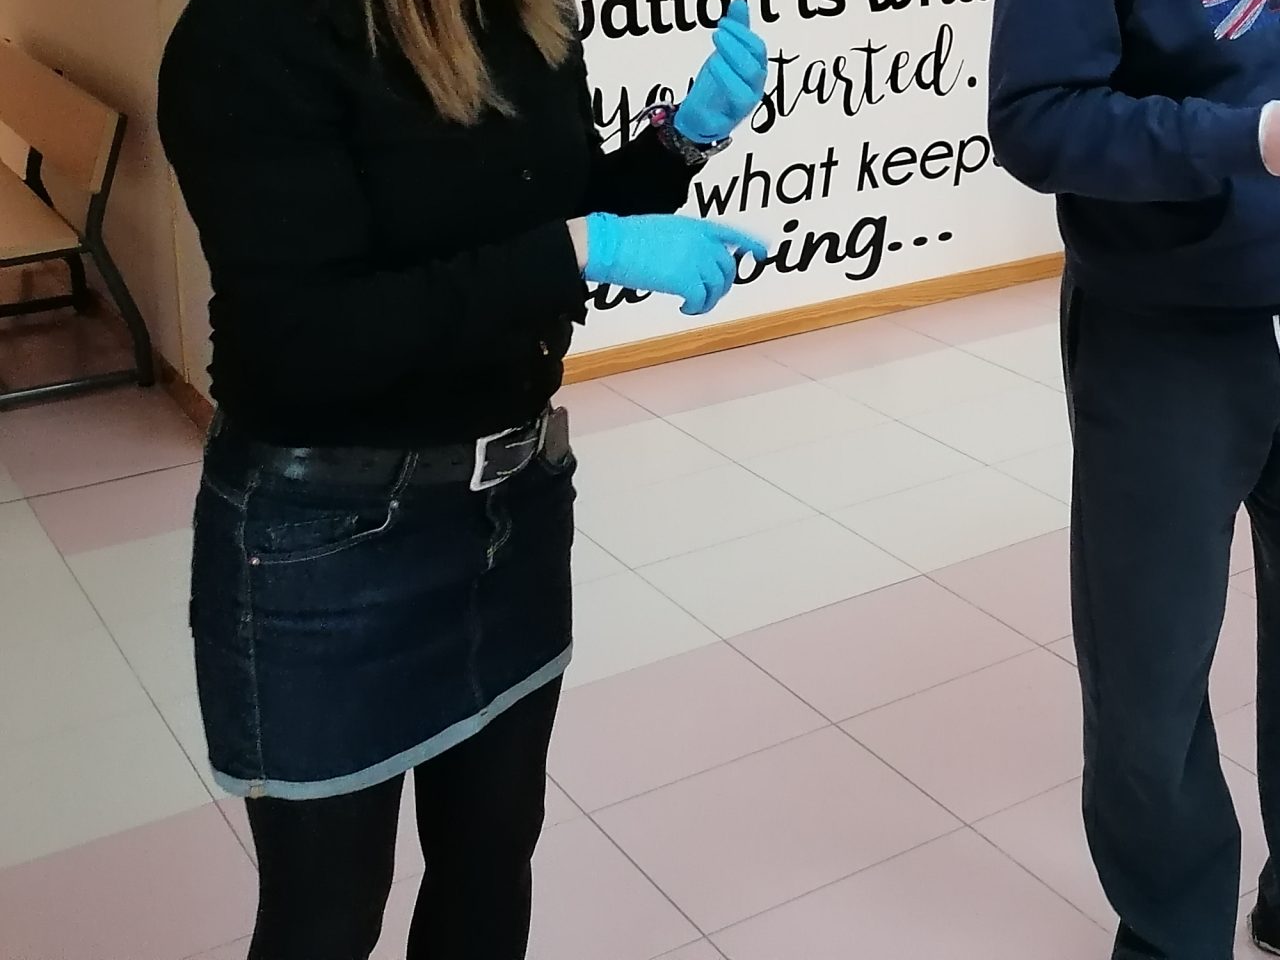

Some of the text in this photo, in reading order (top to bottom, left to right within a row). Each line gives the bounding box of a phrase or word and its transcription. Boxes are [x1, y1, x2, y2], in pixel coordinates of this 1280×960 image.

[694, 134, 1002, 218] what keep
[732, 215, 954, 282] oing...
